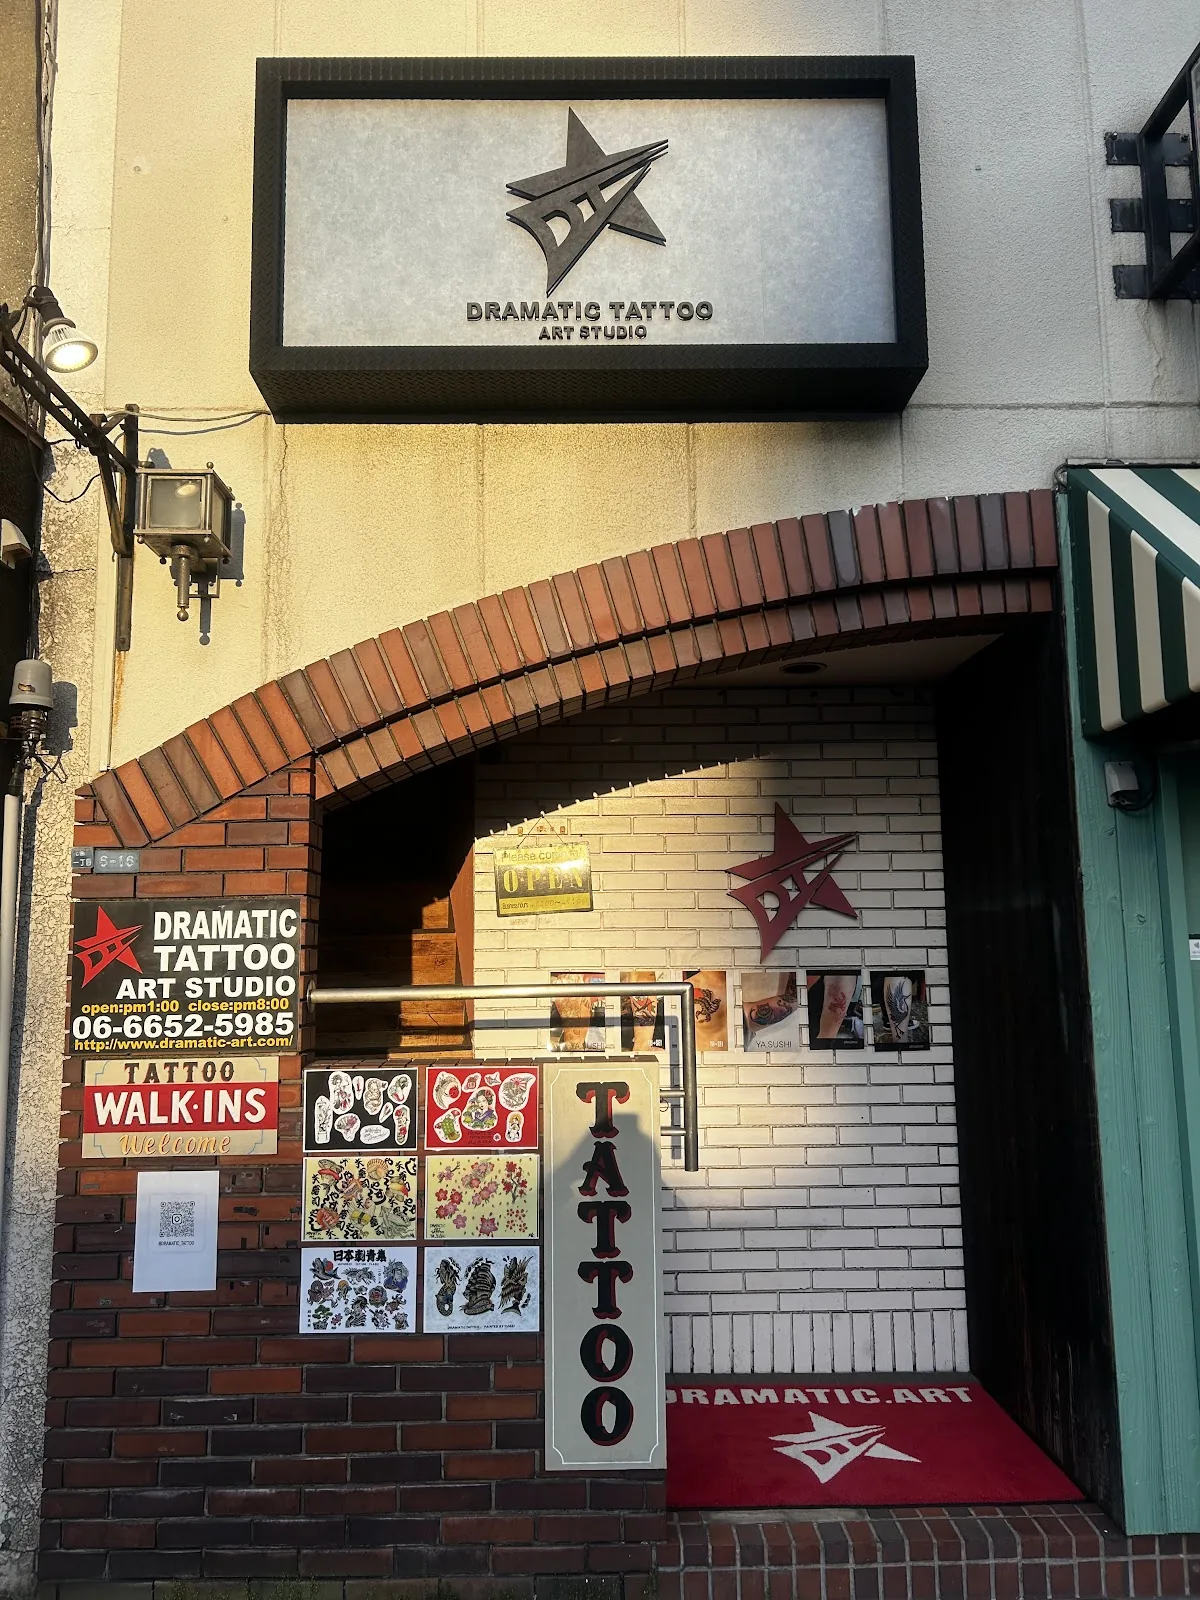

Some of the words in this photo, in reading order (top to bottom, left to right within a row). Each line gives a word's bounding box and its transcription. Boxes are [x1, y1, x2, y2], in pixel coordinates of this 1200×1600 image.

[466, 301, 601, 321] DRAMATIC
[609, 301, 713, 321] TATTOO
[538, 326, 575, 340] ART
[579, 325, 647, 340] STUDIO
[501, 850, 536, 862] Please
[503, 866, 583, 893] OPEN
[153, 908, 298, 941] DRAMATIC
[153, 943, 296, 973] TATTOO
[115, 977, 176, 1000] ART
[184, 975, 296, 999] STUDIO
[81, 1000, 180, 1015] open:pm1:00
[188, 997, 290, 1013] close:pm8:00
[72, 1011, 294, 1040] 06-6652-5985
[74, 1034, 293, 1052] http://www.dramatic-art.com/
[124, 1060, 234, 1084] TATTOO
[119, 1132, 231, 1156] Welcome
[575, 1081, 634, 1447] TATTOO
